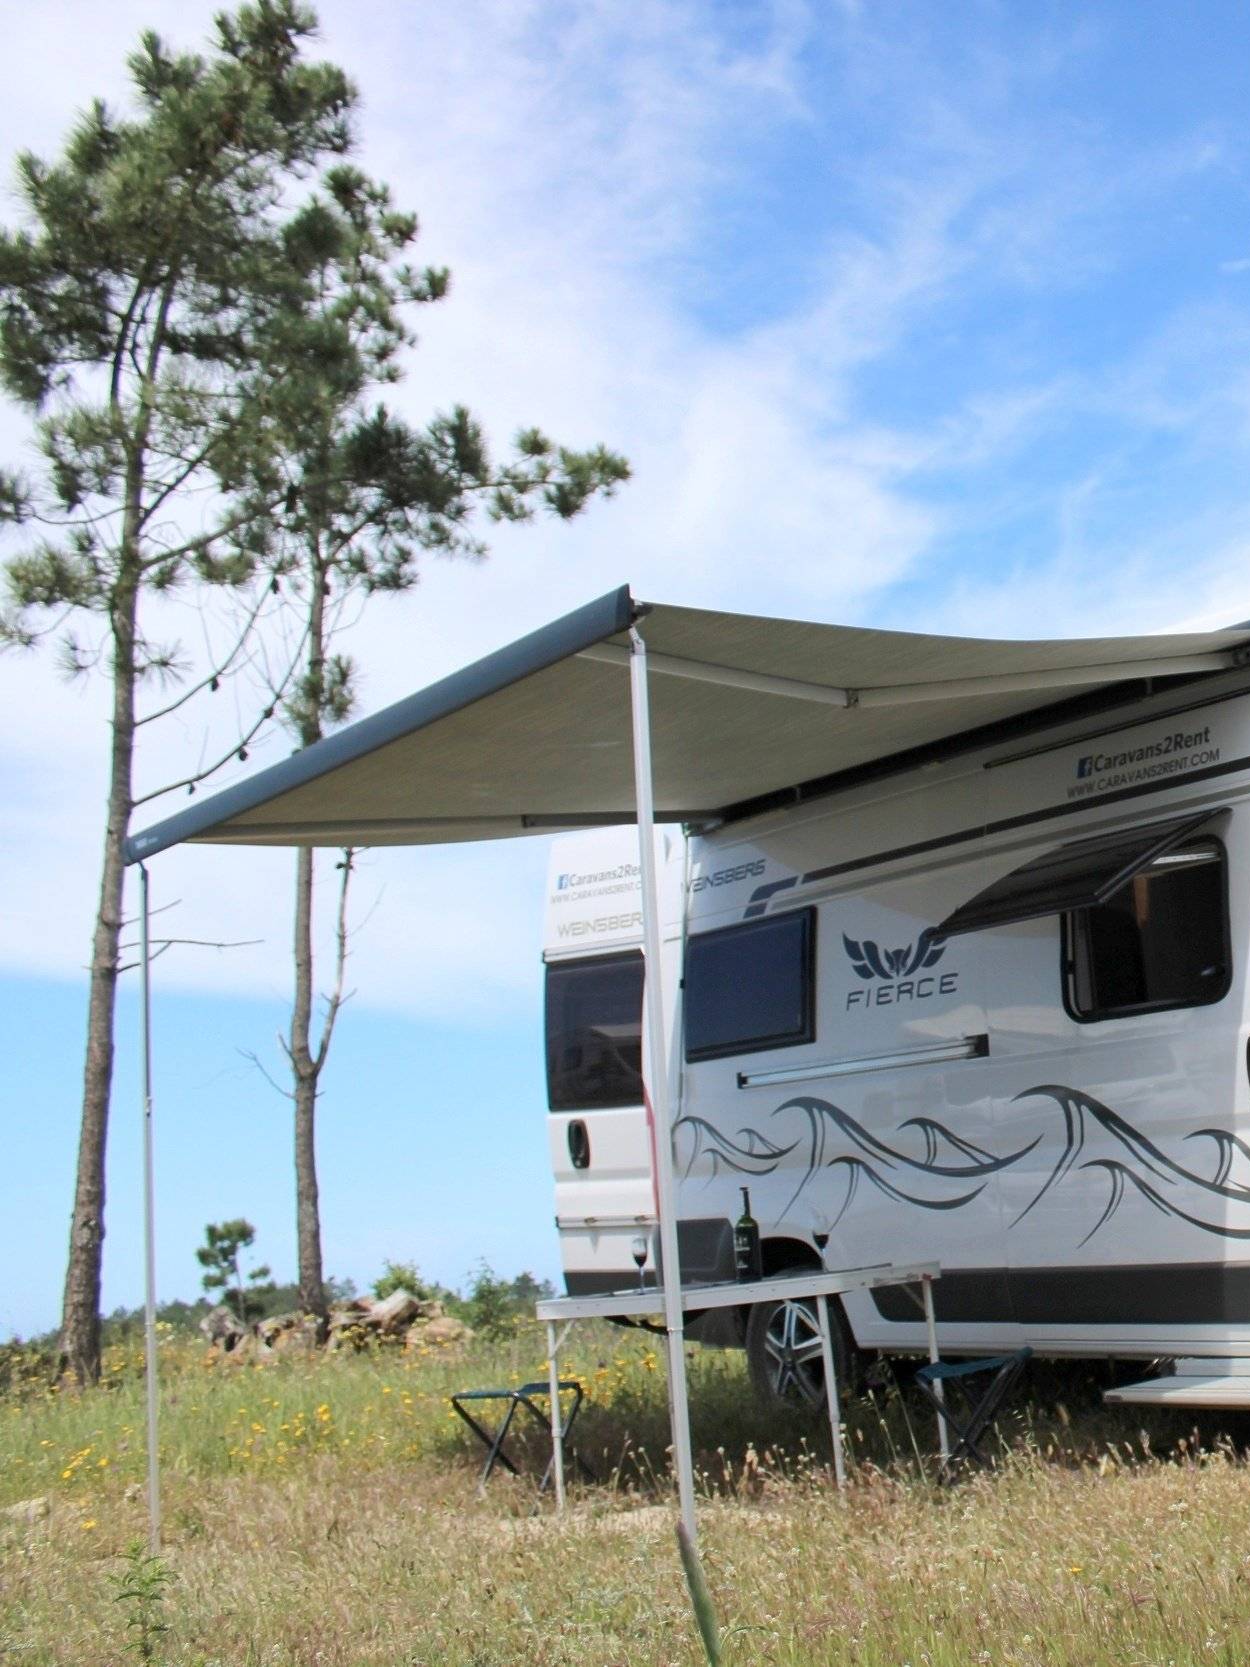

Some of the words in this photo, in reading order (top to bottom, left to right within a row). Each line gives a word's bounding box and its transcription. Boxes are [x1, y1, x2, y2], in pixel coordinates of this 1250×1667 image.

[1094, 726, 1210, 772] Caravans2Rent
[558, 911, 645, 937] WEINSBER
[846, 972, 959, 1011] FIERCE
